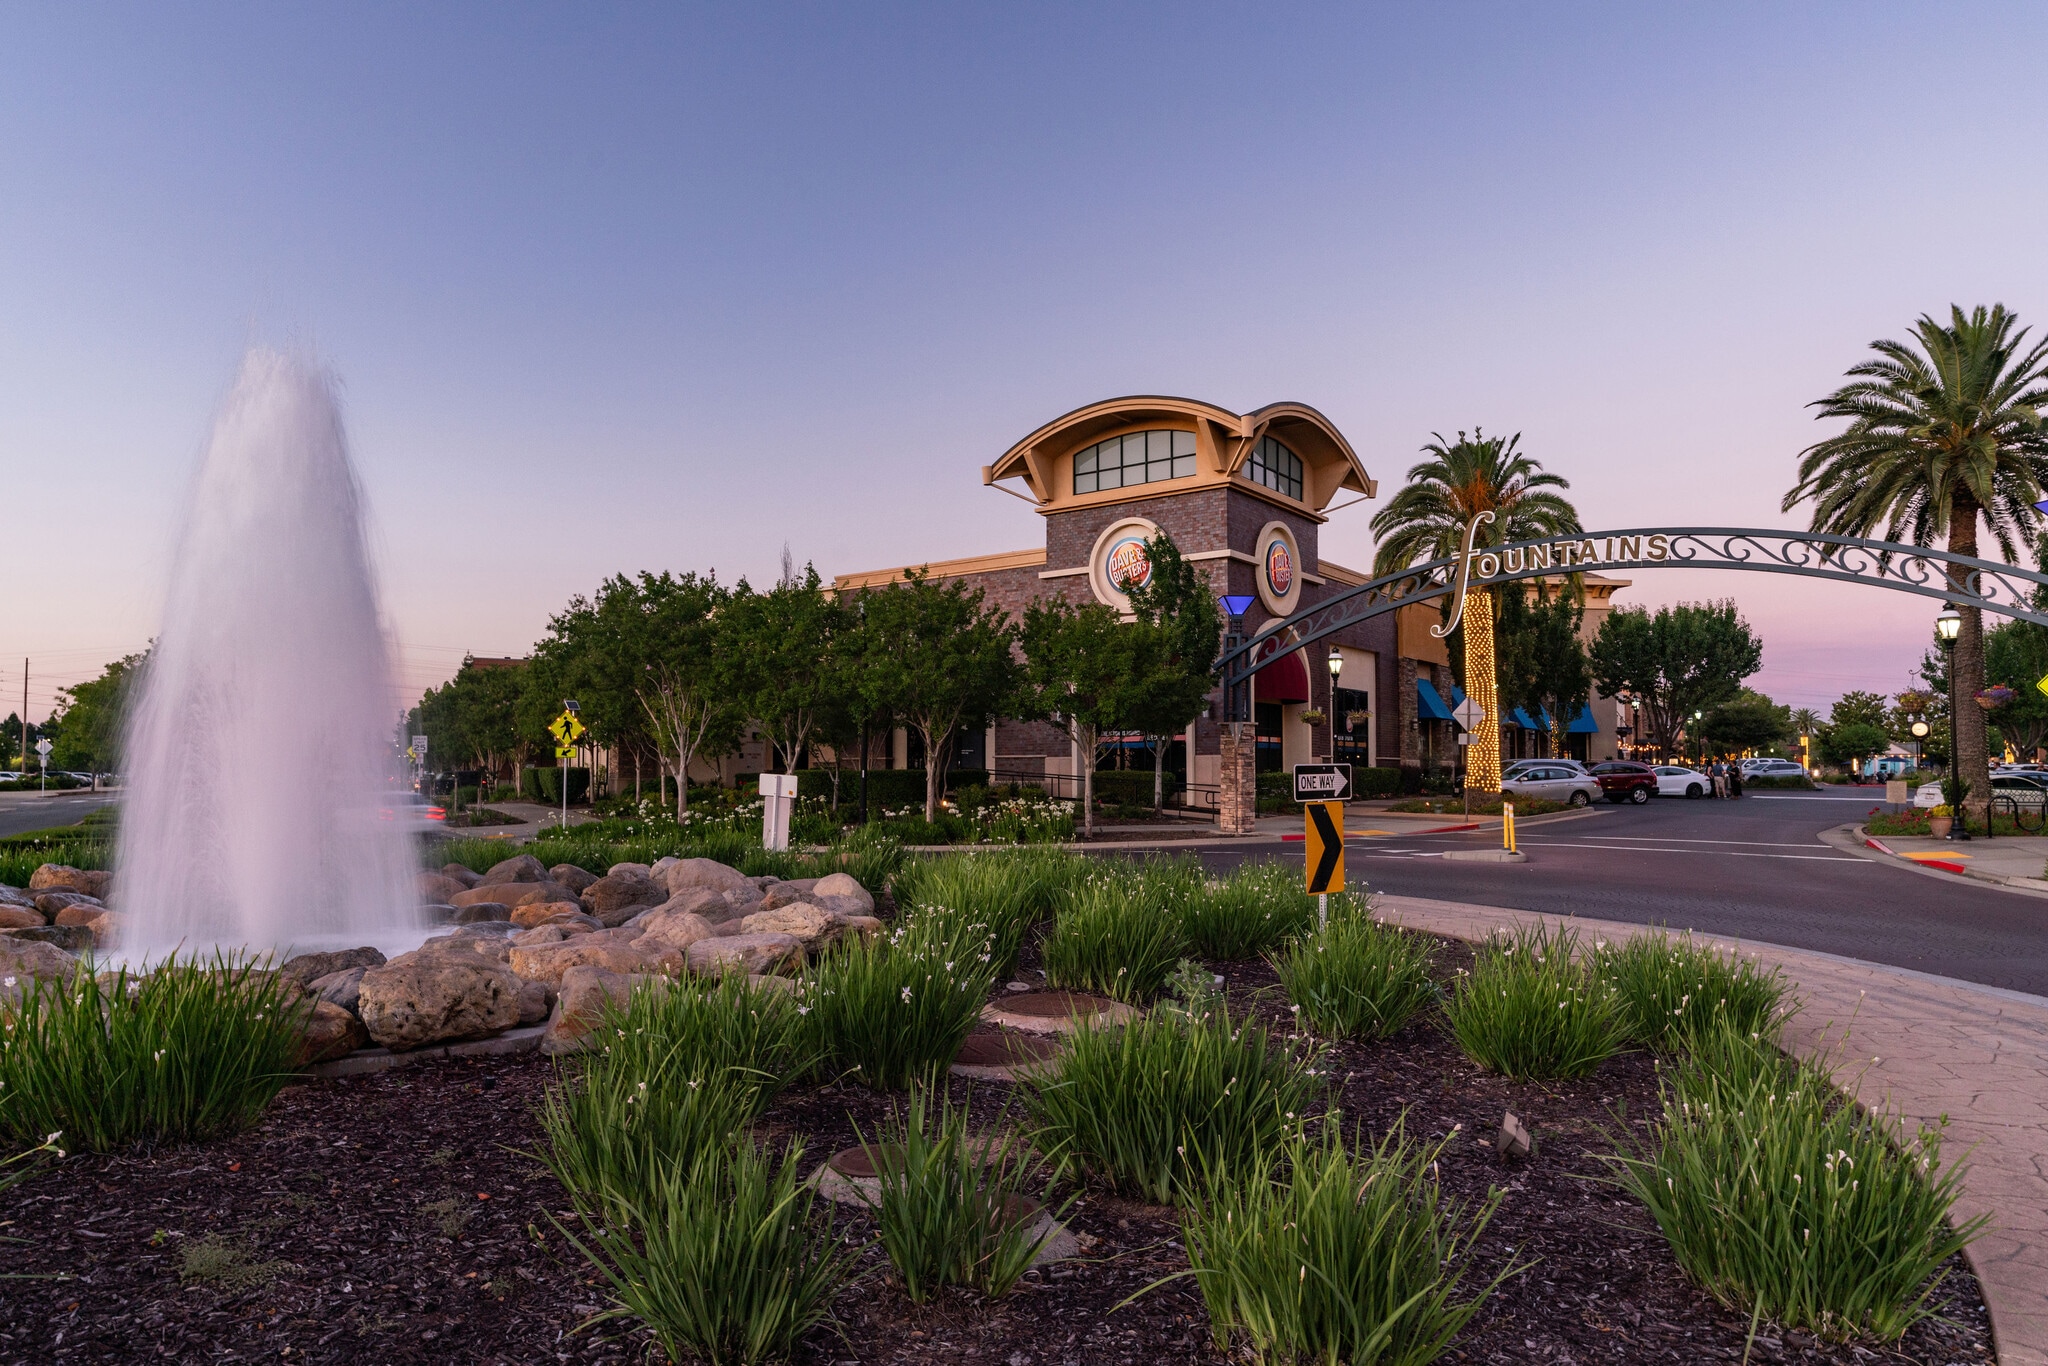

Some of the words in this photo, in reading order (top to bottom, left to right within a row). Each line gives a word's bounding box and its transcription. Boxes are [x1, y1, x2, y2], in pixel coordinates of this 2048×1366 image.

[1111, 550, 1137, 572] DAVE
[1301, 776, 1317, 789] ONE
[1319, 775, 1335, 789] WAY
